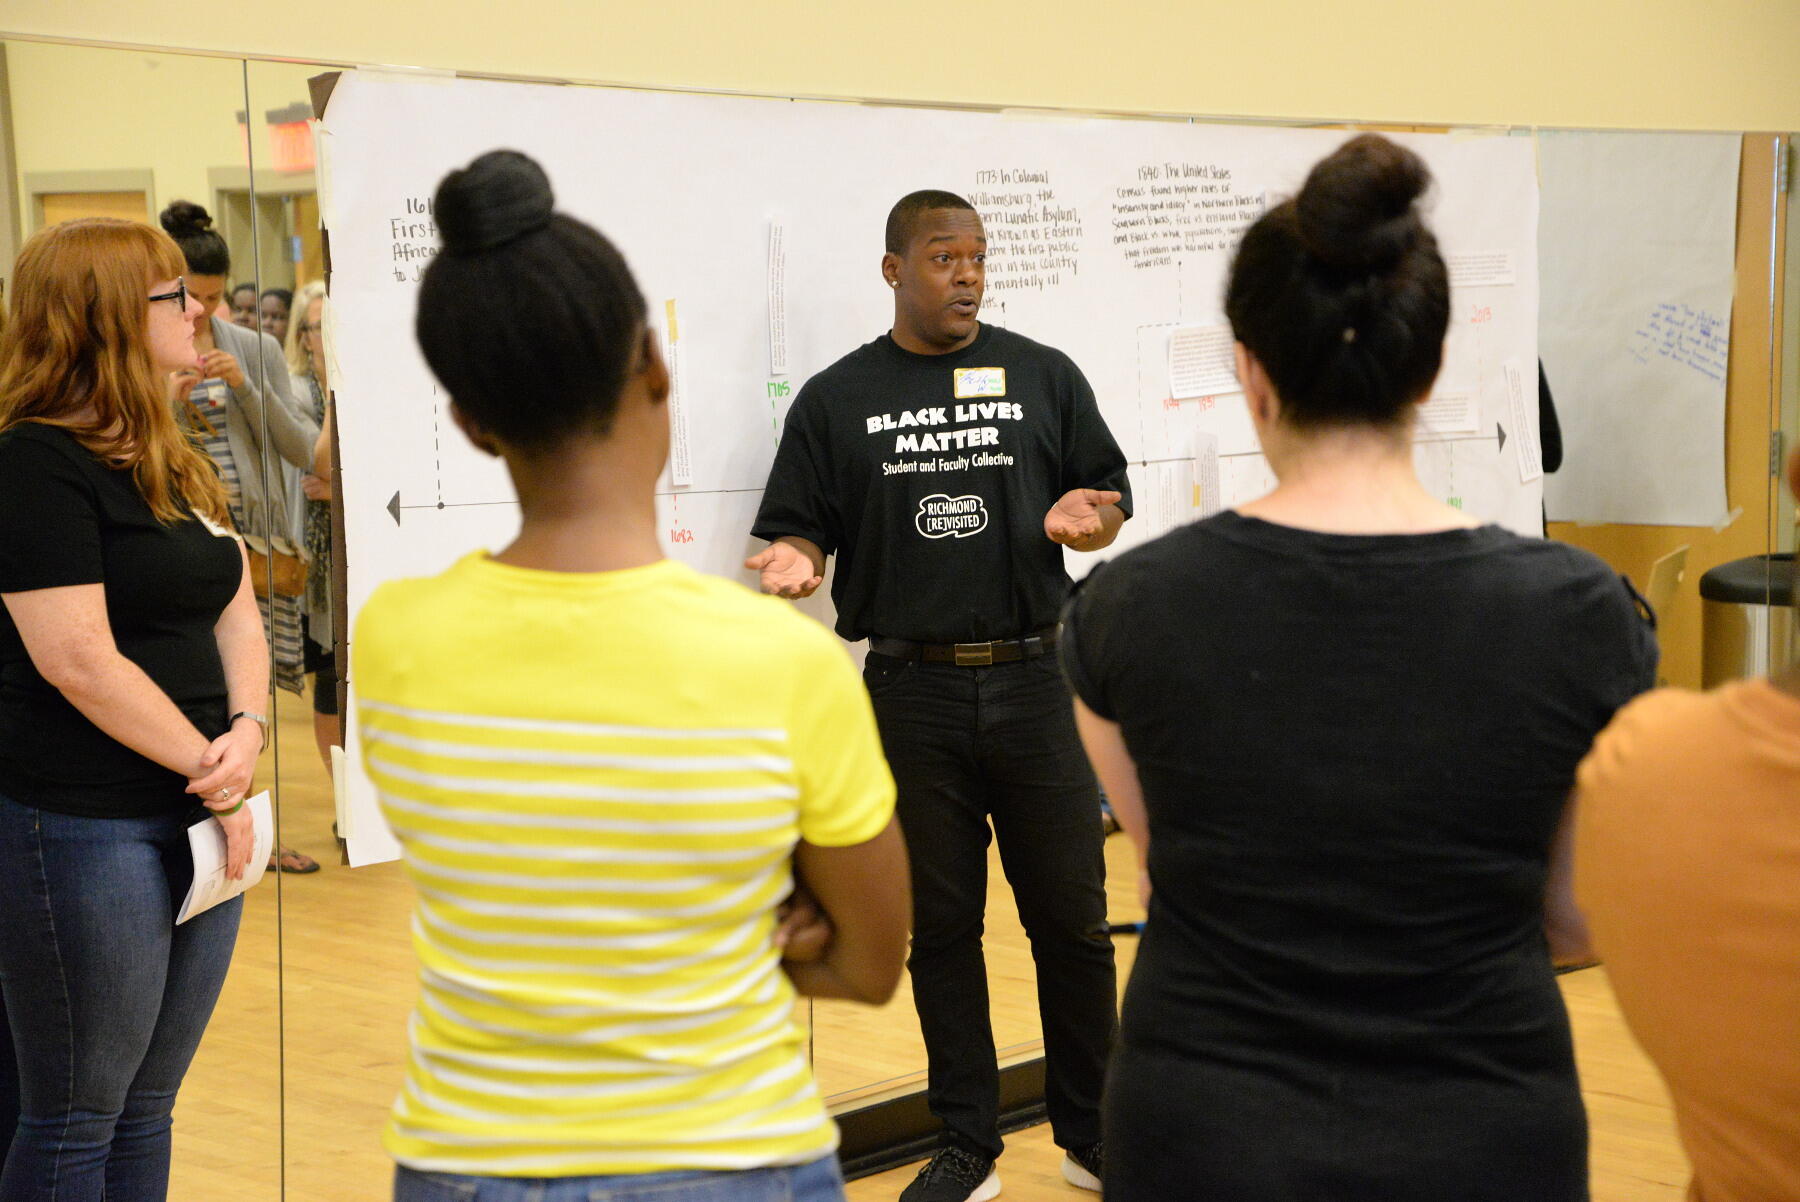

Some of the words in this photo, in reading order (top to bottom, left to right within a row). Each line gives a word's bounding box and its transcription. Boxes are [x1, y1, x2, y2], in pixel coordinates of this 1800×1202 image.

[1000, 169, 1011, 184] In
[1012, 168, 1049, 184] Colonial
[1164, 162, 1179, 179] The
[1182, 162, 1208, 178] United
[1036, 188, 1055, 201] the
[1151, 185, 1172, 197] found
[1175, 184, 1198, 201] higher
[1221, 182, 1231, 193] of
[406, 197, 433, 215] 161
[1004, 209, 1039, 225] Lunatic
[1042, 204, 1081, 227] Asylum,
[390, 217, 437, 240] First
[1043, 226, 1083, 240] Eastern
[393, 242, 440, 262] Africa
[1048, 240, 1080, 258] public
[392, 265, 407, 282] to
[1020, 259, 1036, 272] the
[1039, 255, 1078, 276] country
[994, 275, 1044, 292] mentally
[1047, 271, 1059, 286] ill
[767, 380, 791, 398] 1705
[866, 407, 949, 434] BLACK
[955, 401, 1024, 423] LIVES
[895, 426, 1000, 454] MATTER
[882, 458, 918, 476] Student
[919, 457, 936, 472] and
[938, 454, 970, 472] Faculty
[971, 451, 1014, 468] Collective
[927, 499, 977, 516] RICHMOND
[926, 514, 980, 532] [RE]VISITED
[671, 528, 694, 544] 1682
